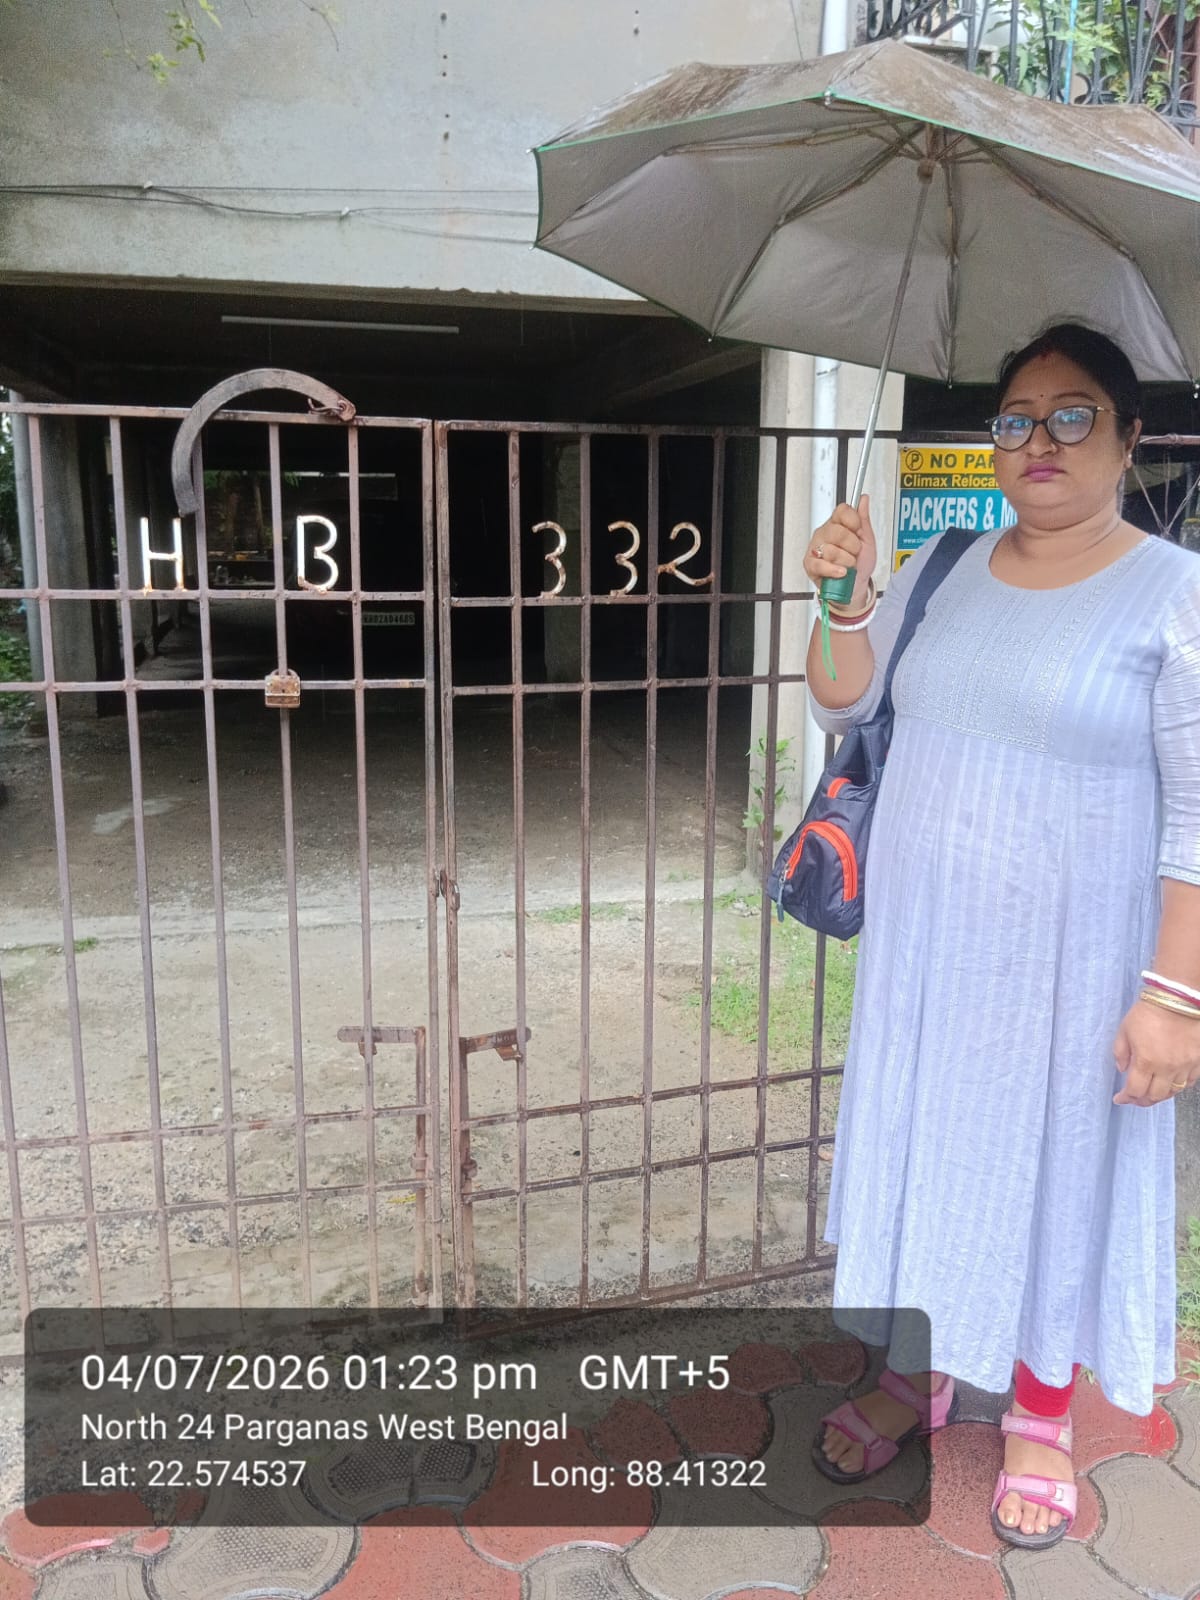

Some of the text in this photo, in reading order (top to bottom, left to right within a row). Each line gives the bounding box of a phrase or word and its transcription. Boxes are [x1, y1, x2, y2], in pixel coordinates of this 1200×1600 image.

[930, 453, 957, 469] NO
[903, 474, 948, 487] Climax
[900, 496, 978, 531] PACKERS
[982, 496, 995, 531] &
